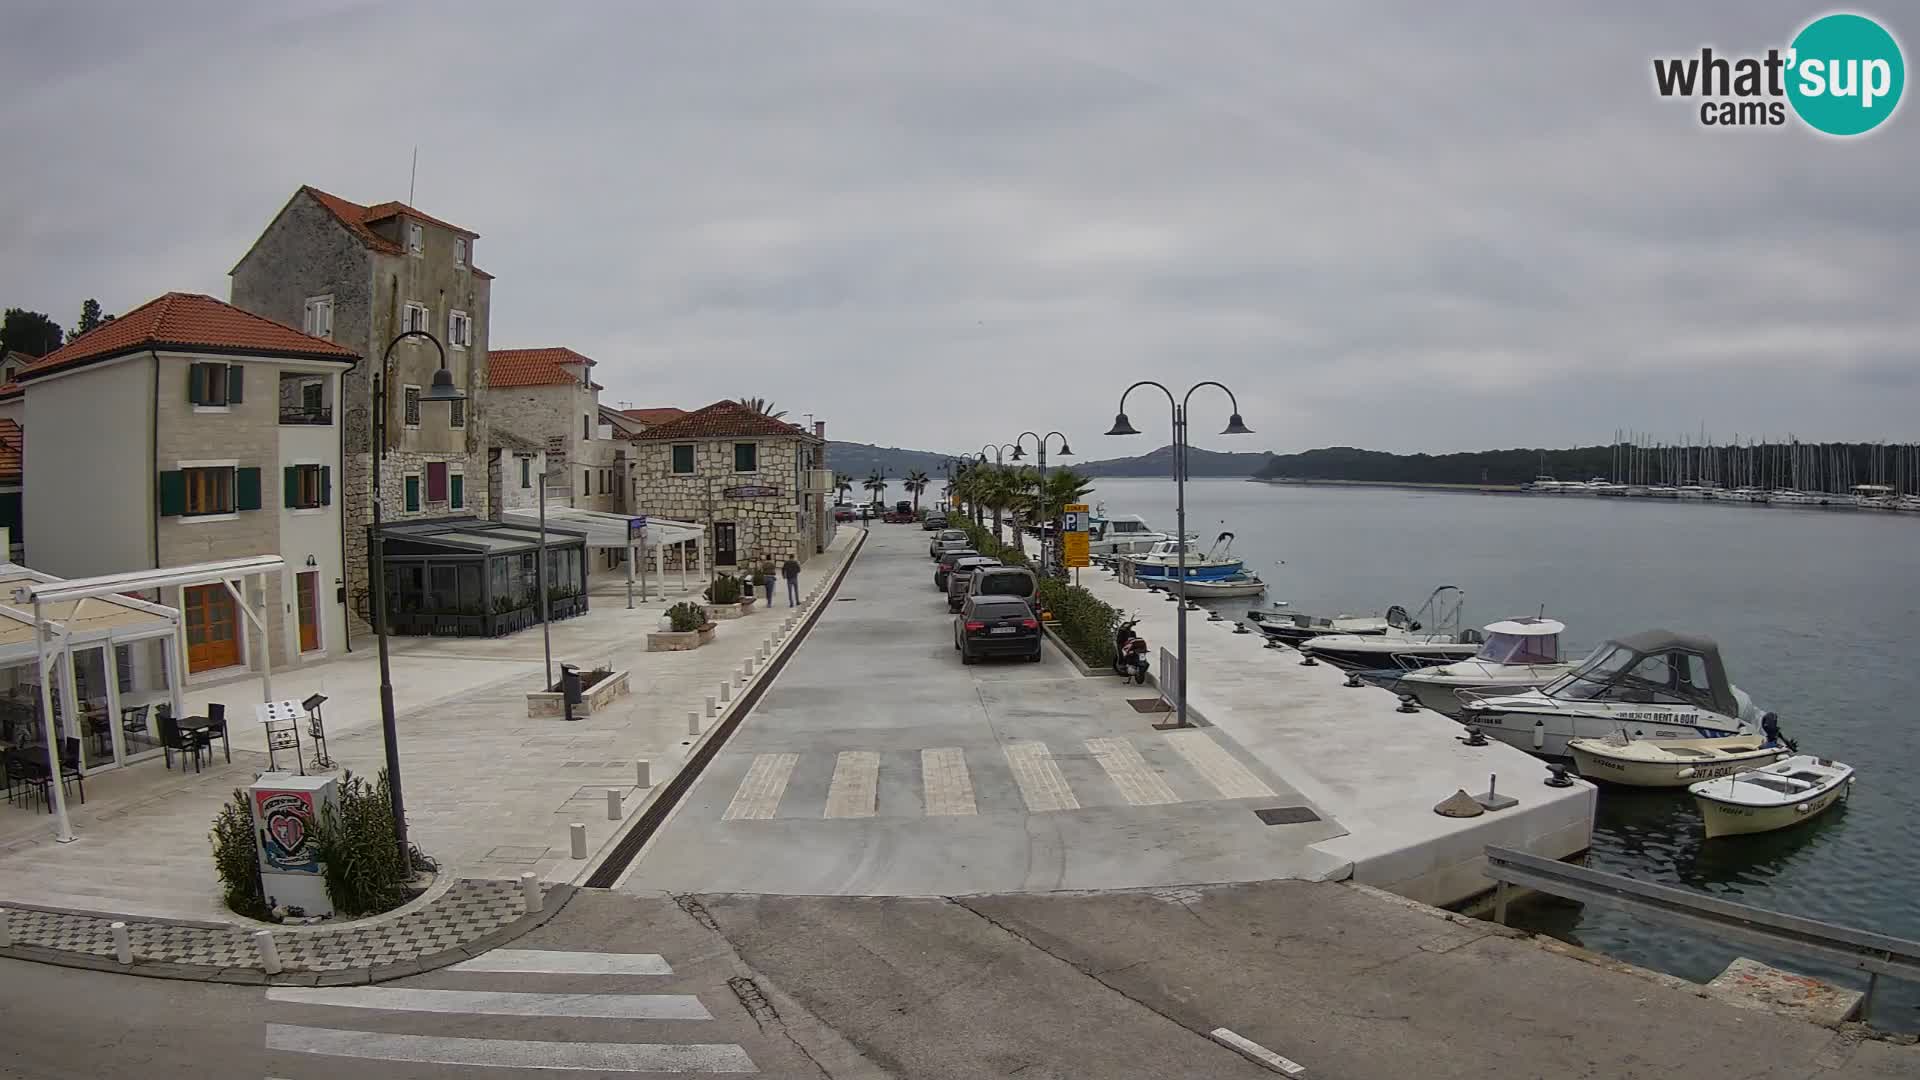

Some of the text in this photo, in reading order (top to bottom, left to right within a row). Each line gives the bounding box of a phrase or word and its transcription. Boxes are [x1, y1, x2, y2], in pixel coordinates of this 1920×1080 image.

[1066, 514, 1076, 530] P
[1653, 712, 1699, 725] RENT A BOAT
[1707, 768, 1713, 777] A
[1714, 767, 1733, 777] BOAT
